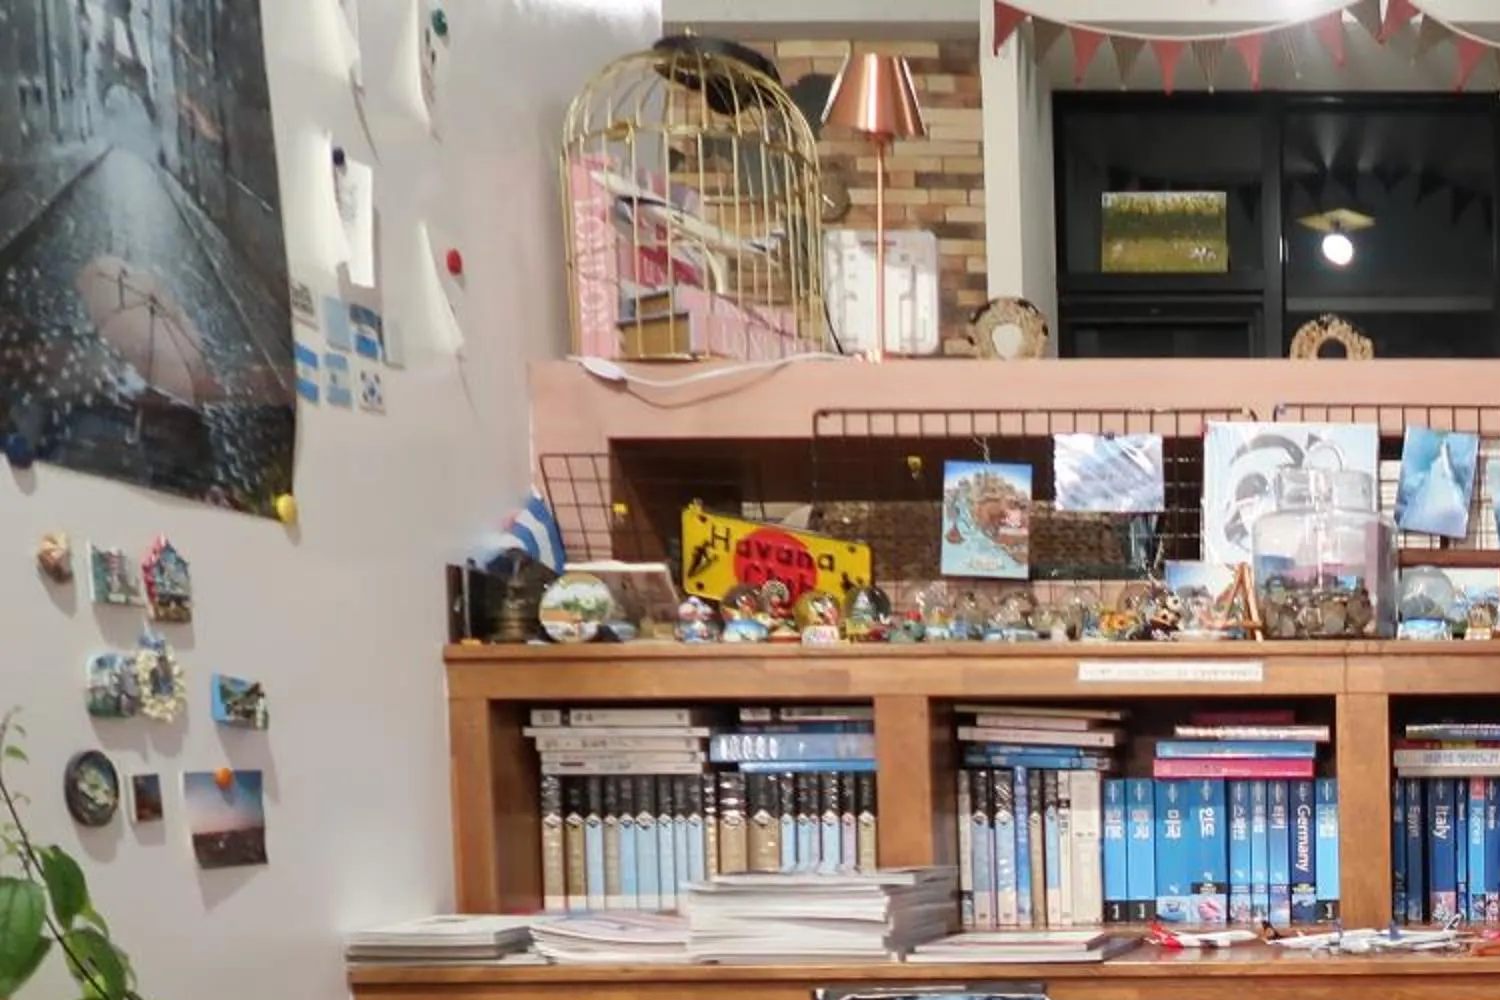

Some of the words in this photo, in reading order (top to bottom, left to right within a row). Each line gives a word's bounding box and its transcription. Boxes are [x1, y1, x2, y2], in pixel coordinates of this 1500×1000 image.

[710, 525, 836, 572] Havana
[1199, 806, 1216, 838] 인도
[1295, 804, 1312, 872] Germany
[1432, 805, 1452, 840] Italy
